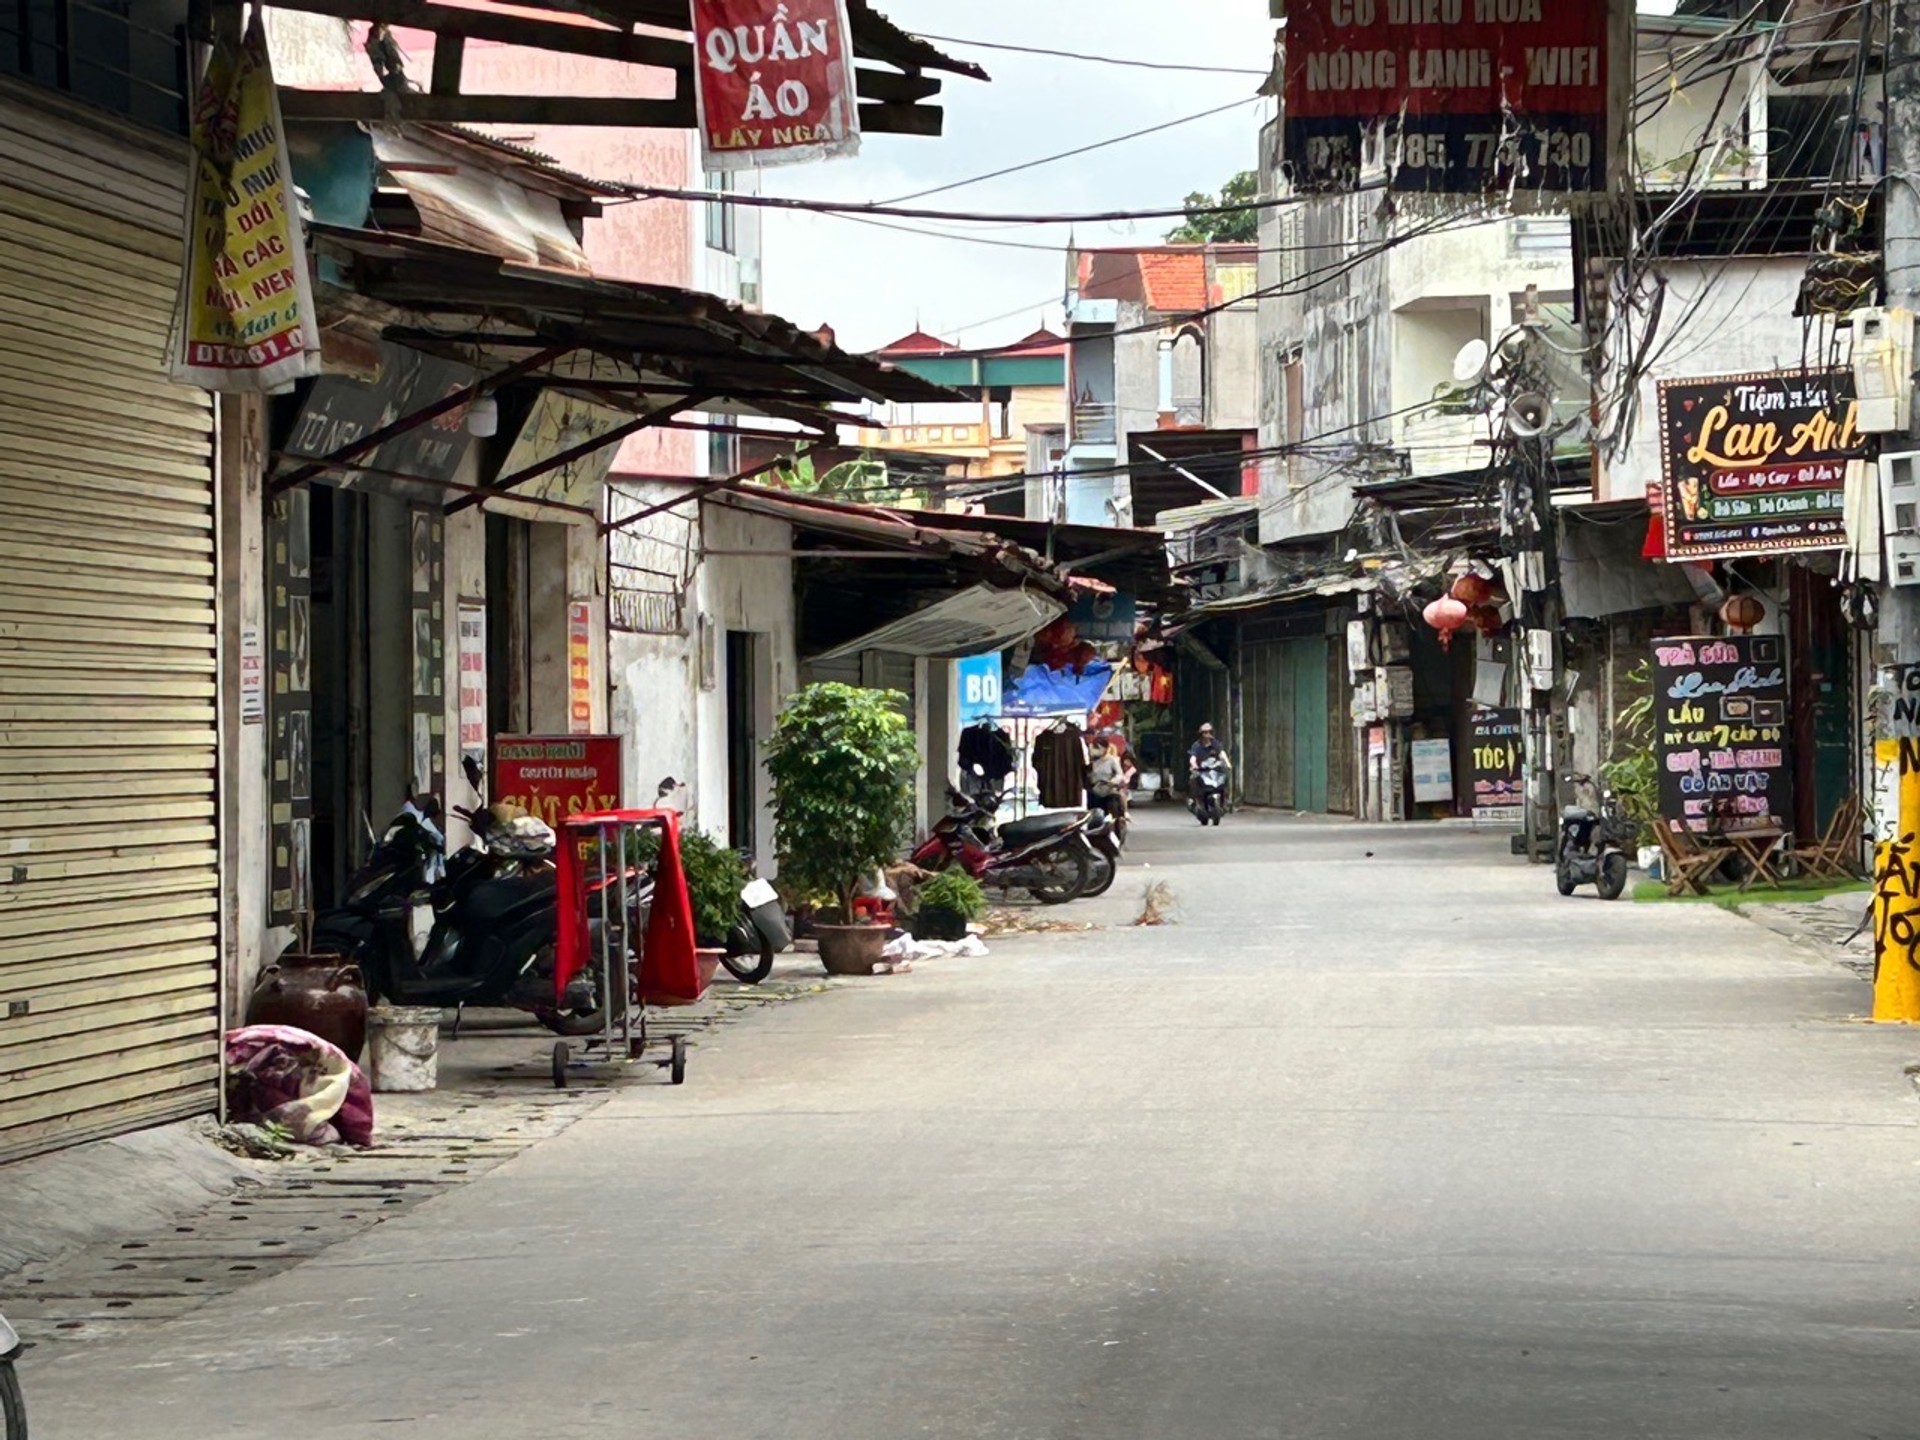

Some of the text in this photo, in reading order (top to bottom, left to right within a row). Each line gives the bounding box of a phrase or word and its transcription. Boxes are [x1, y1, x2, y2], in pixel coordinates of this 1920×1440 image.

[706, 3, 828, 73] QUẦN
[1306, 46, 1397, 91] NÓNG
[1525, 47, 1598, 86] WIFI
[741, 71, 809, 120] ÁO
[1735, 385, 1786, 416] Tiệm
[1687, 405, 1783, 468] Lan
[1713, 725, 1730, 747] 7
